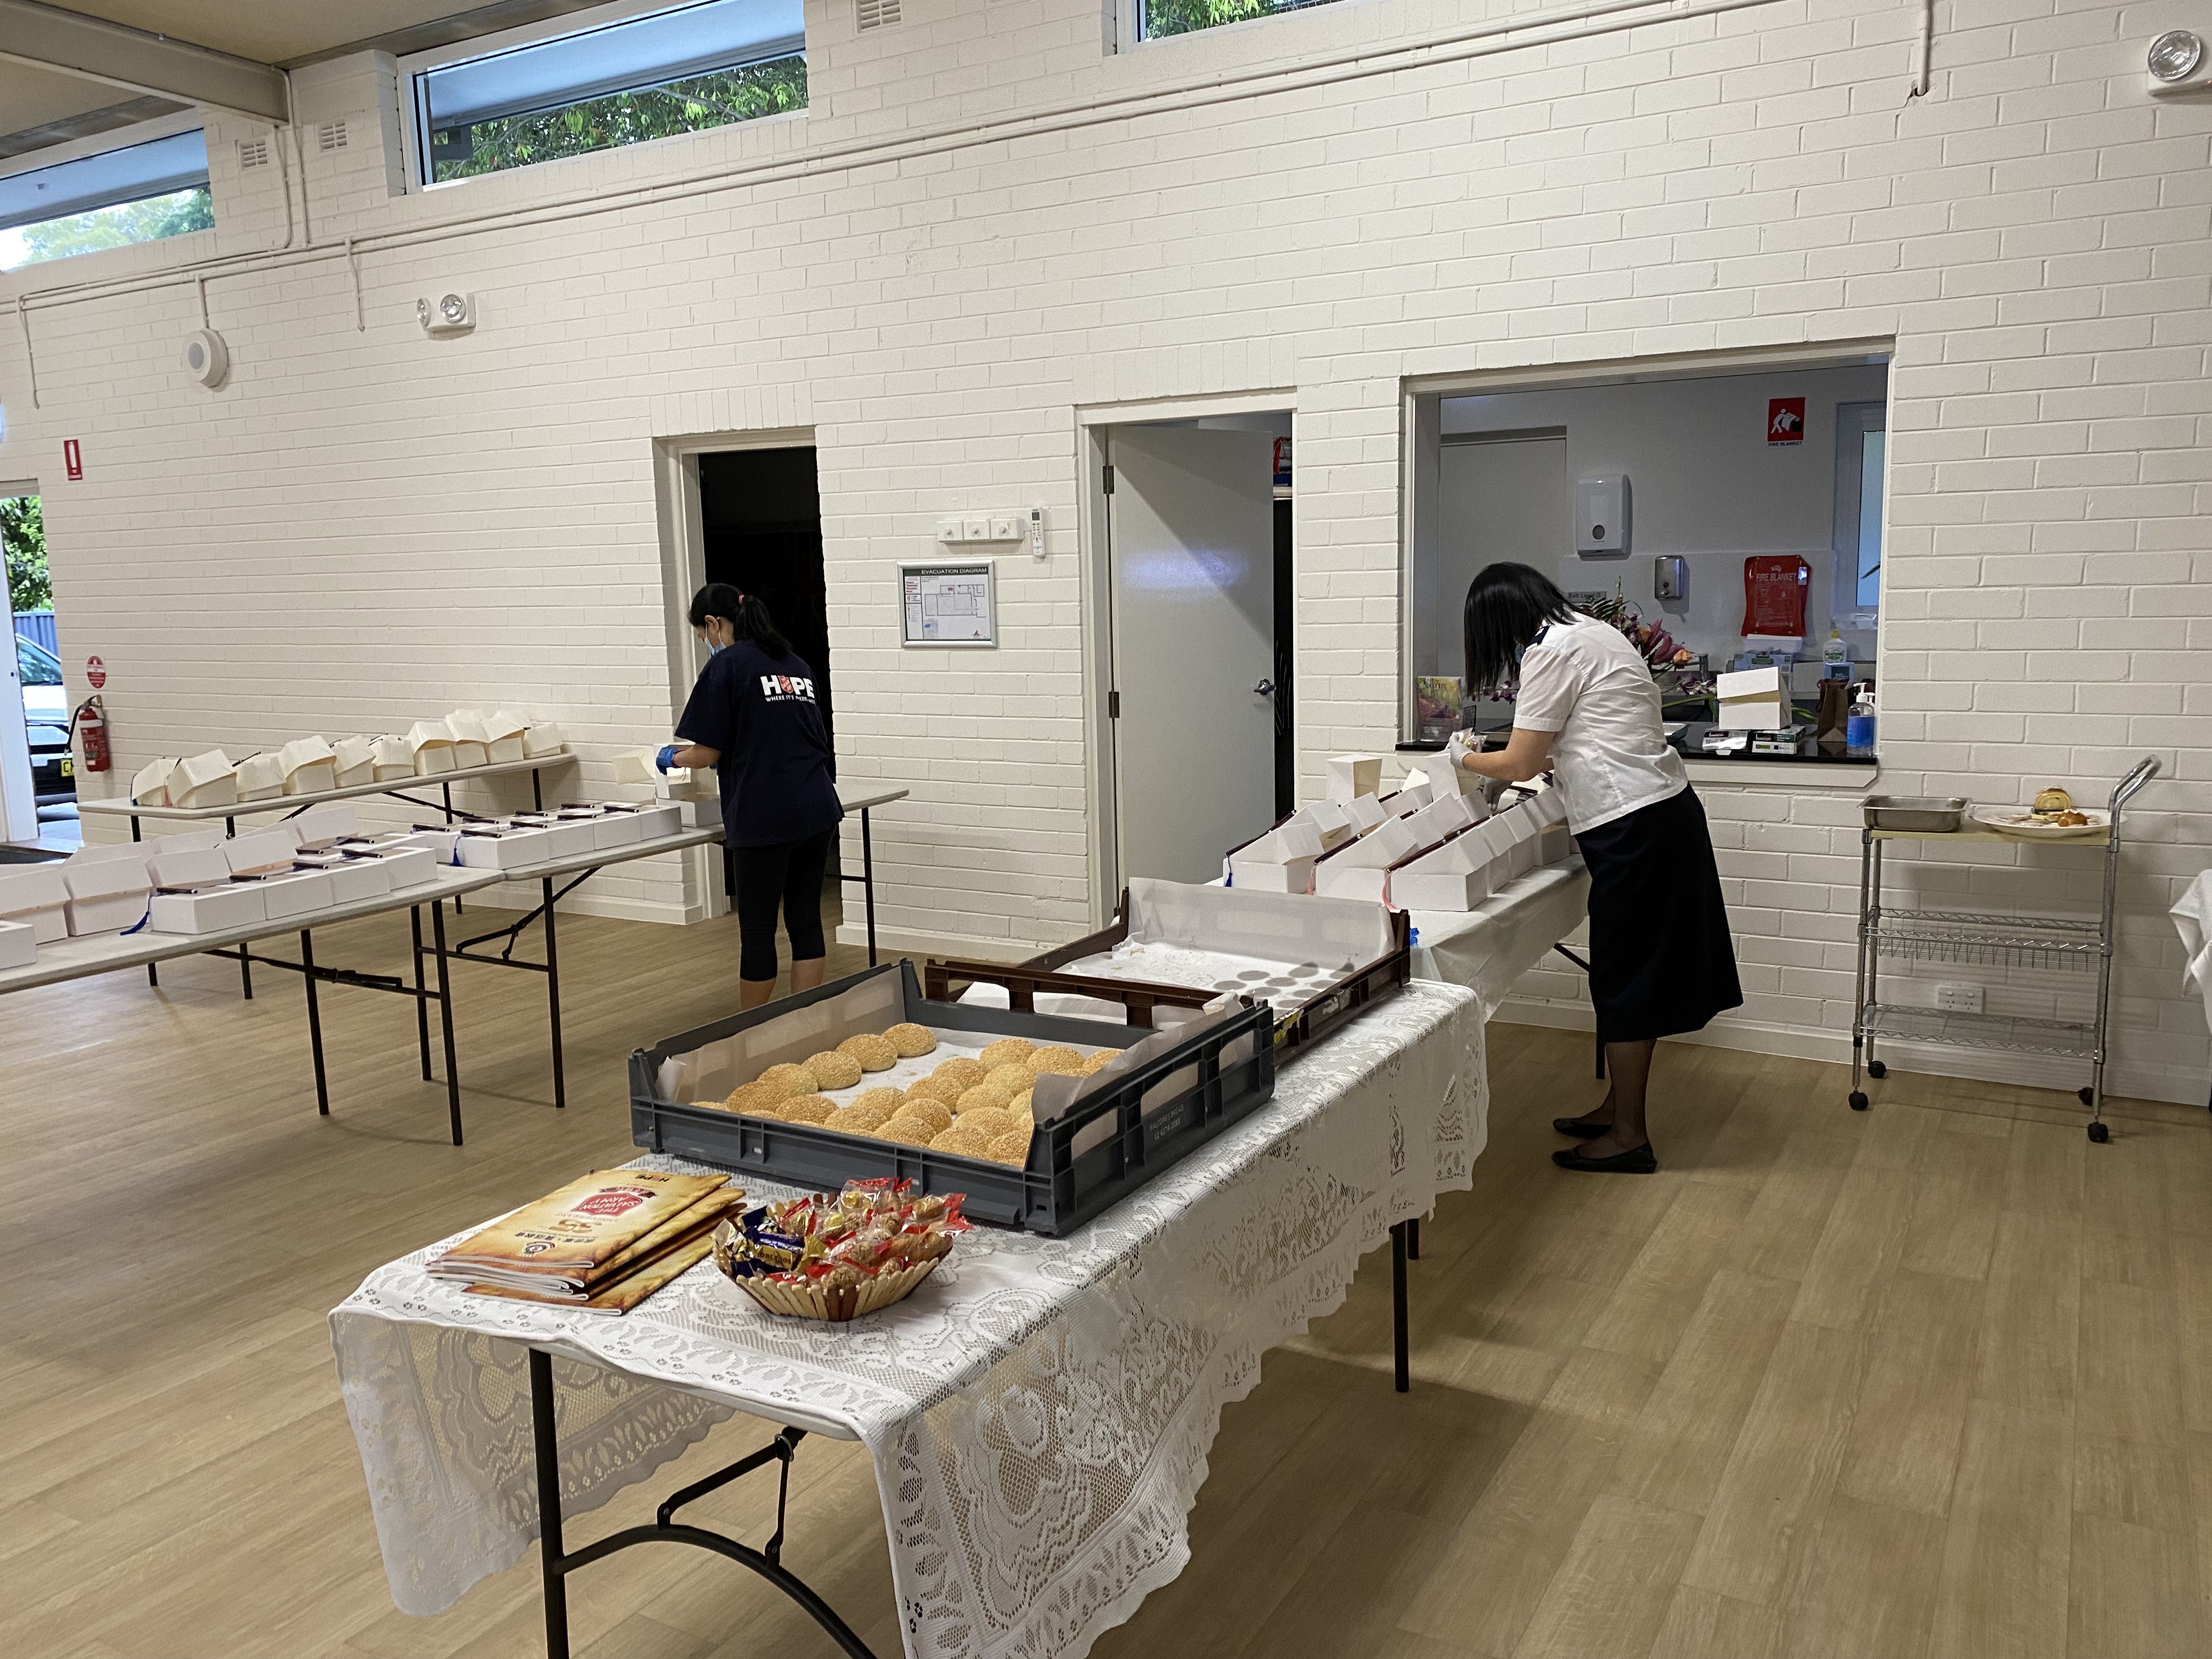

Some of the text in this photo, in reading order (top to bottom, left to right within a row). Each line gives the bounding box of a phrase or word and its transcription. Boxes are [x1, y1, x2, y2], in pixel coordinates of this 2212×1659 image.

[1756, 573, 1797, 582] FIRE BLANKET
[589, 1196, 629, 1204] ARMY
[579, 1200, 639, 1211] SALVATION
[547, 1219, 602, 1234] 35
